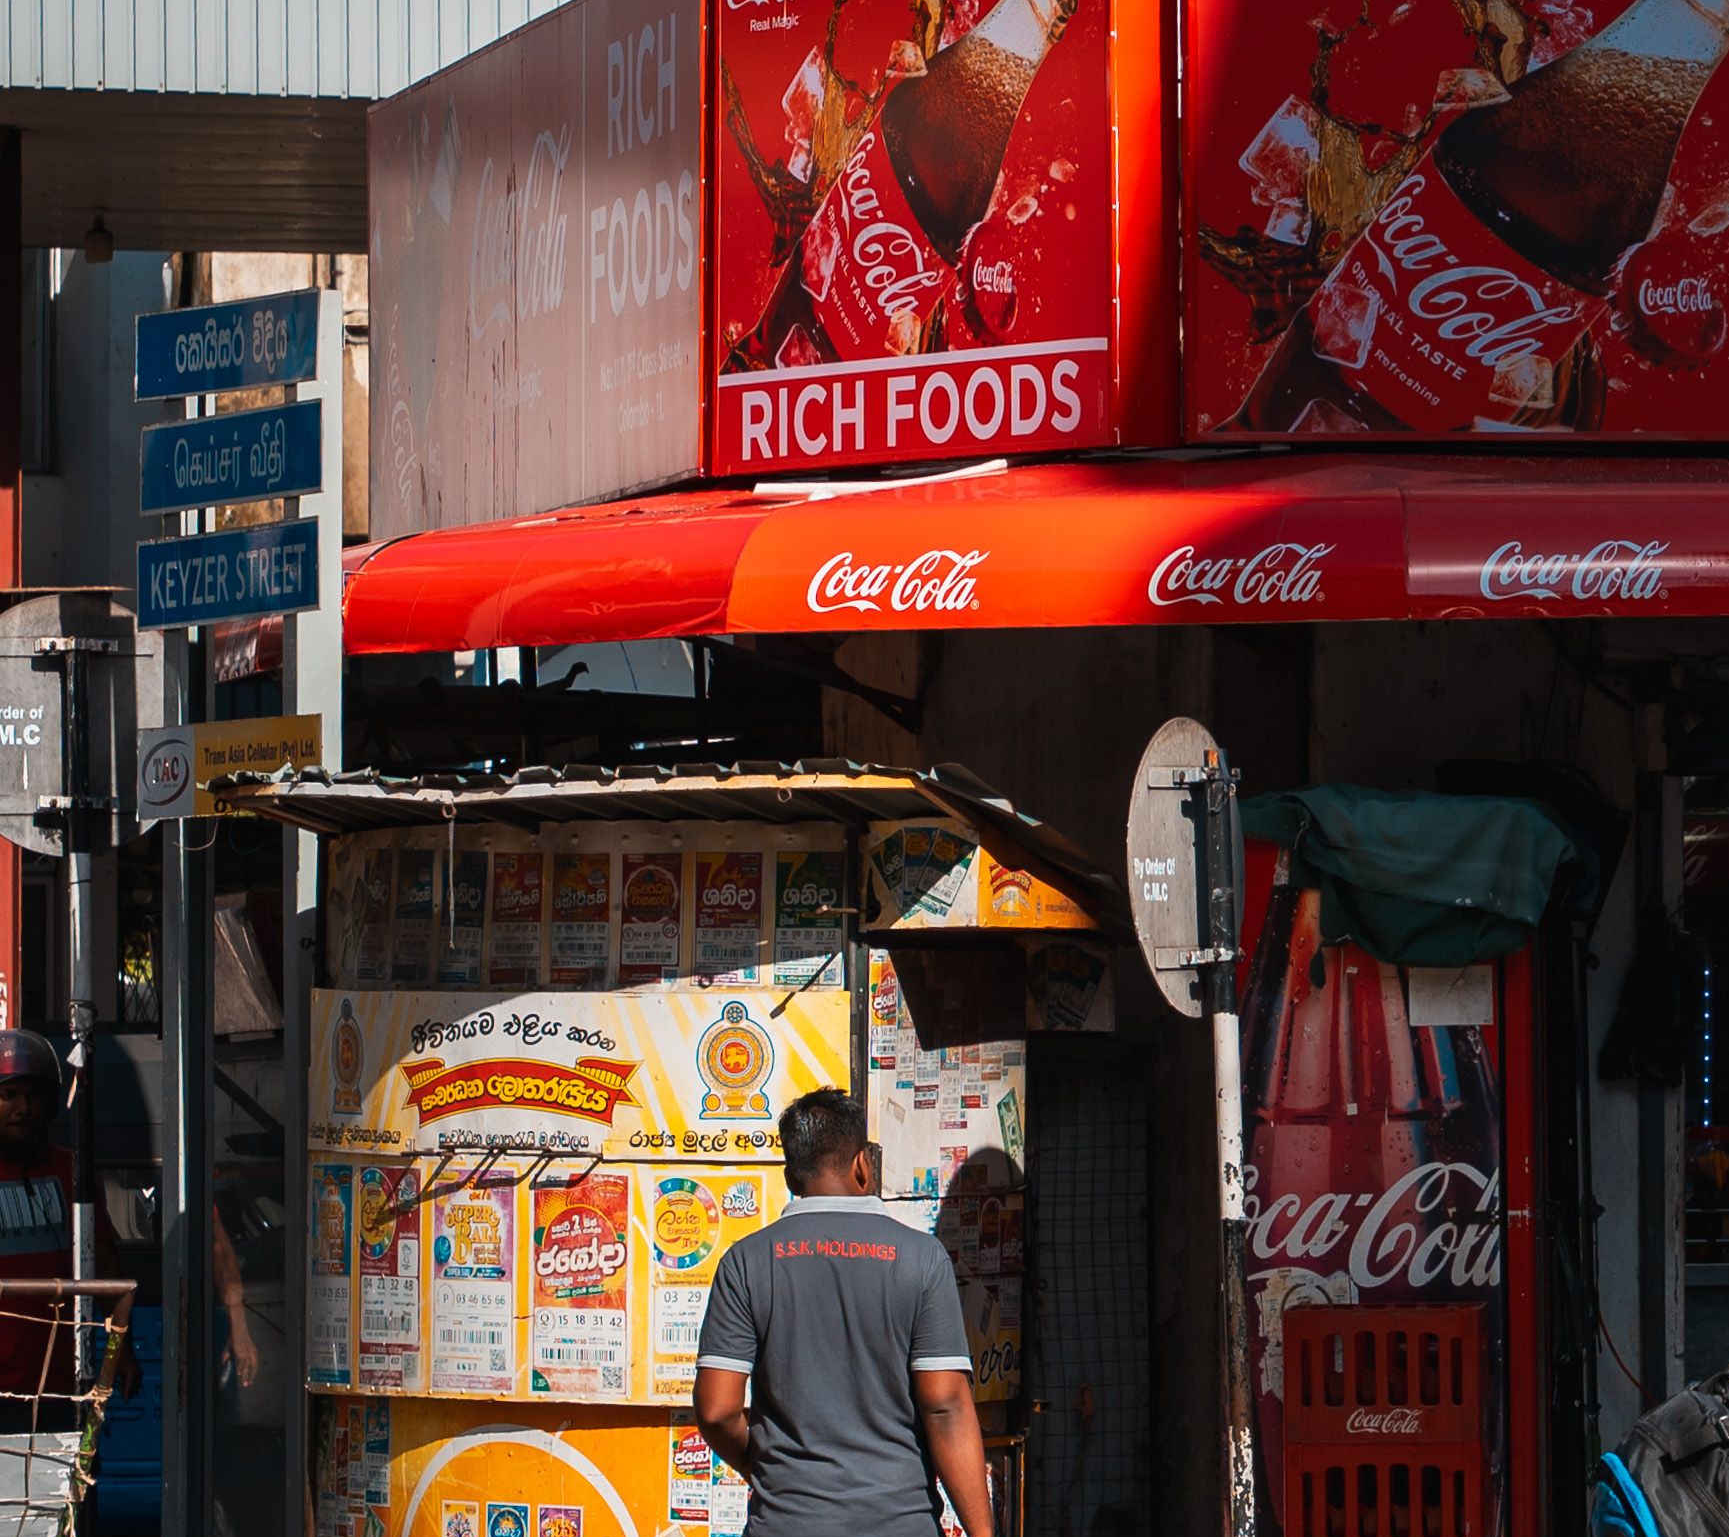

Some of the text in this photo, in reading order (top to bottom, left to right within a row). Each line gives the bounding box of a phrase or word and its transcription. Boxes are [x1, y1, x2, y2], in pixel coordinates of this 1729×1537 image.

[750, 14, 800, 32] Real Magic
[607, 12, 677, 160] RICH
[590, 168, 694, 324] FOODS
[972, 255, 1016, 293] Coca-Cola
[850, 277, 877, 326] TASTE
[1639, 278, 1713, 316] Coca-Cola
[1409, 332, 1468, 381] TASTE
[1374, 349, 1442, 407] Refreshing
[741, 359, 1082, 461] RICH FOODS
[249, 419, 287, 490] வீதி
[151, 543, 306, 611] KEYZER STREET
[807, 550, 992, 613] Coca-Cola
[1148, 542, 1337, 607] Coca-Cola
[1479, 540, 1671, 601] Coca-Cola
[29, 705, 44, 719] of
[204, 739, 316, 766] Trans Asia Cellular (Pvt) Ltd.
[152, 756, 180, 784] TAC
[1133, 859, 1143, 879] By
[1145, 858, 1165, 876] Order
[1143, 882, 1168, 903] C.M.C
[566, 1025, 616, 1052] කරන
[683, 1129, 728, 1153] මුදල්
[444, 1204, 500, 1228] SUPER
[452, 1223, 502, 1265] BALL
[775, 1241, 897, 1262] S.S.K. HOLDINGS
[390, 1278, 400, 1291] 32
[403, 1279, 414, 1292] 48
[663, 1291, 702, 1303] 03 29
[558, 1316, 568, 1326] 15
[575, 1315, 586, 1326] 18
[593, 1316, 604, 1327] 31
[609, 1317, 622, 1328] 42
[1347, 1408, 1423, 1435] Coca-Cola
